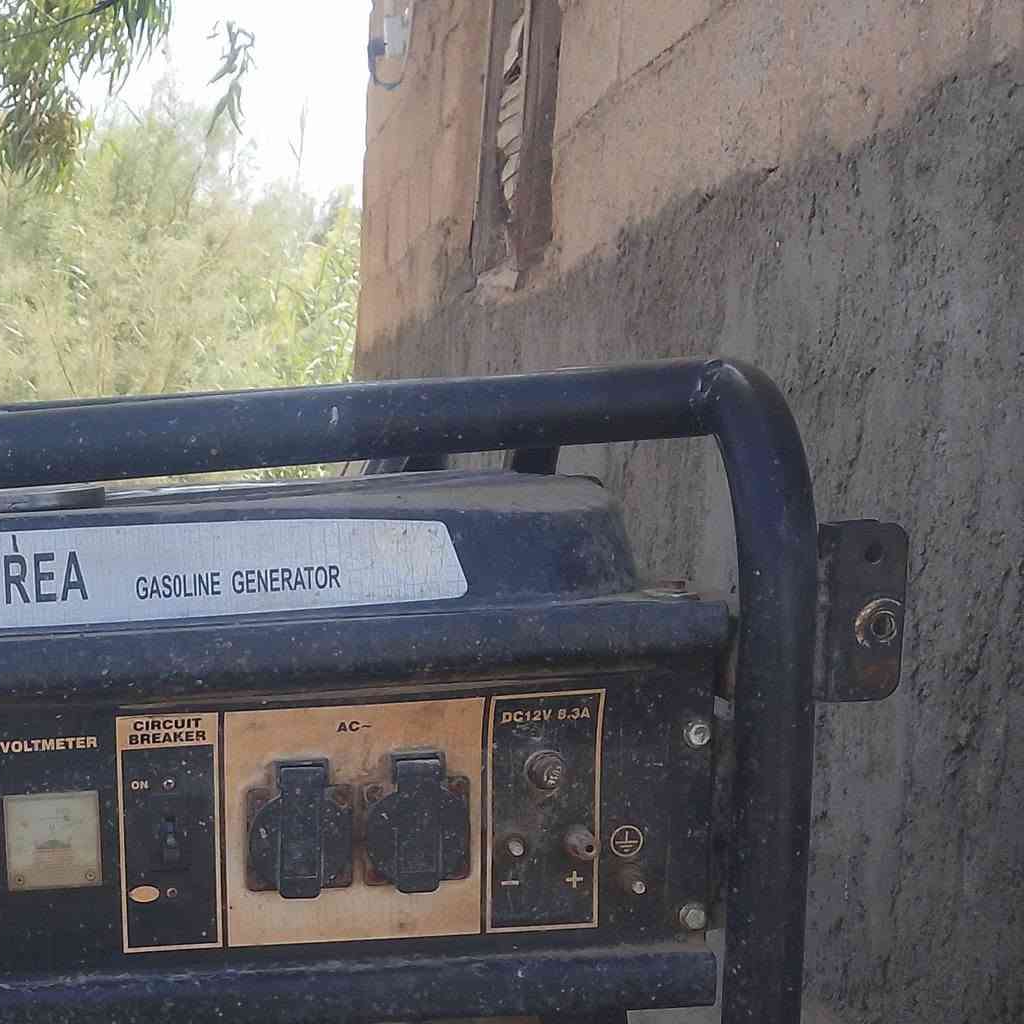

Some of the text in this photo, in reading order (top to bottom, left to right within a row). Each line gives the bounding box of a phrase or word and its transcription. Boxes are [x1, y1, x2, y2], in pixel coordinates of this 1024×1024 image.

[135, 571, 221, 600] GASOLINE
[231, 565, 342, 595] GENERATOR
[502, 709, 552, 722] DC12V
[133, 718, 203, 731] CIRCUIT
[0, 736, 98, 753] VOLTMETER
[128, 730, 207, 745] BREAKER
[131, 780, 149, 790] ON
